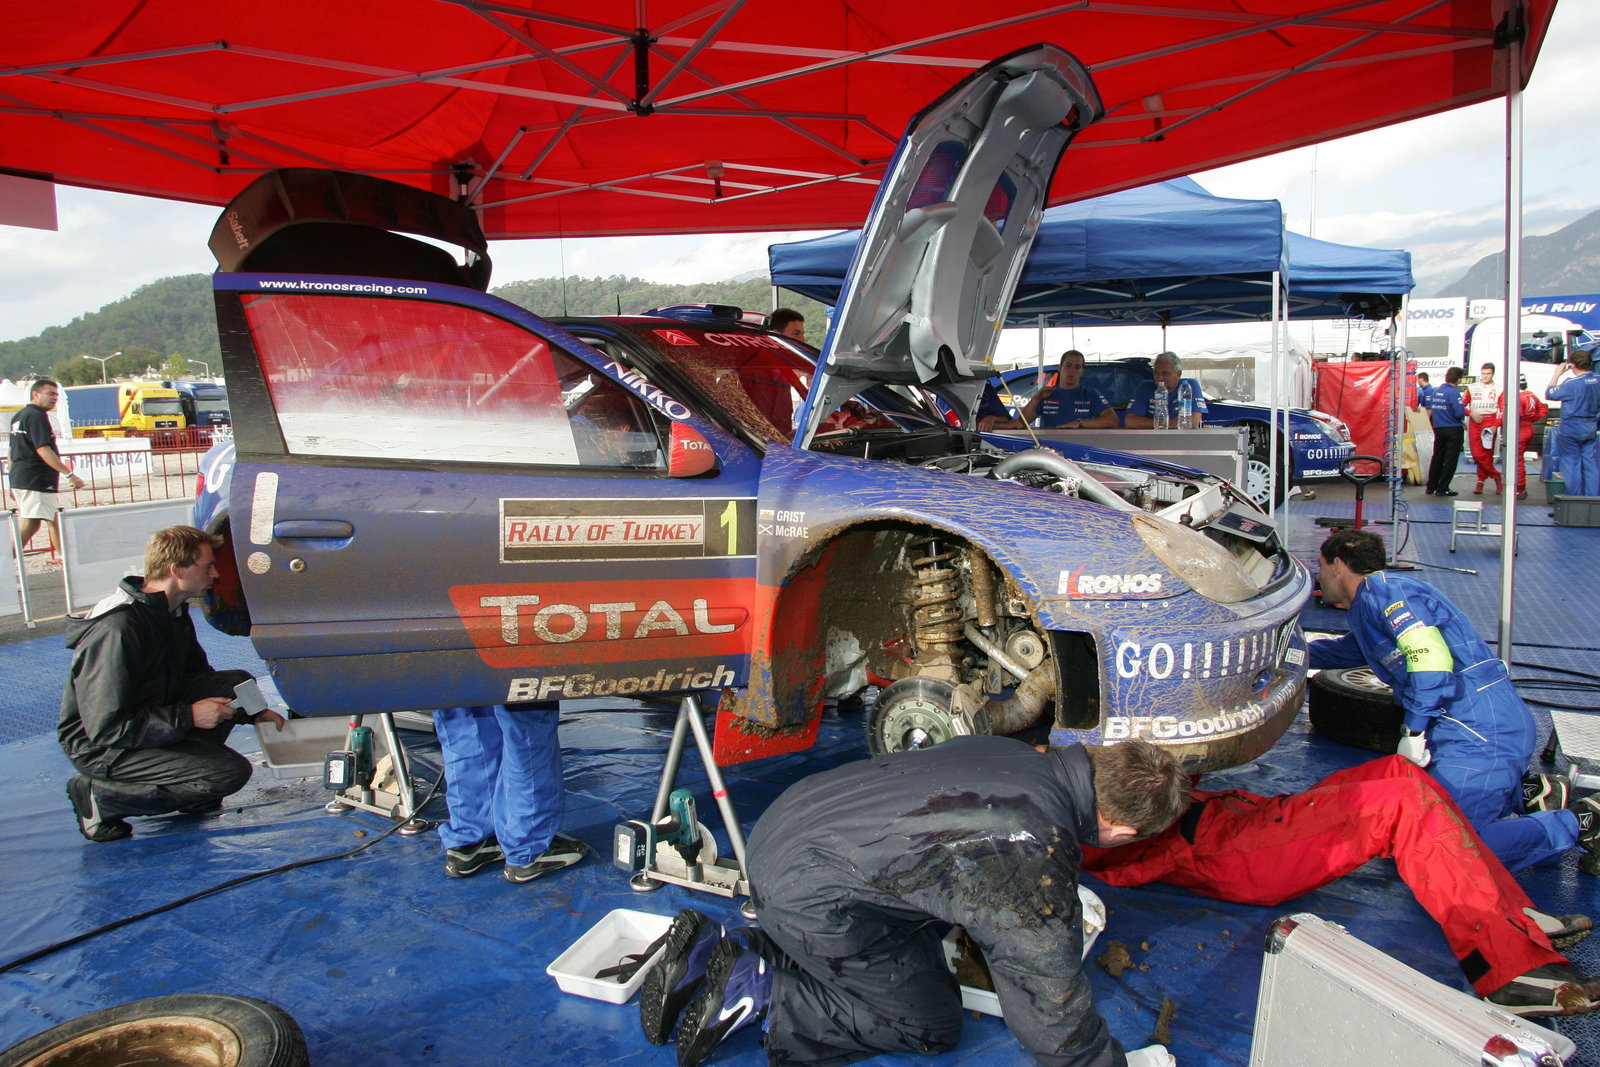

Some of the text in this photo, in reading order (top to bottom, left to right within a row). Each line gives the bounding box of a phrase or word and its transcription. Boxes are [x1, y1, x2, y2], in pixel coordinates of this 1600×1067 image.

[227, 210, 249, 249] Sabelt
[259, 280, 428, 295] www.kronosracing.com
[1405, 308, 1455, 319] RONOS
[1473, 305, 1487, 315] C2
[1550, 302, 1597, 314] Rally
[704, 332, 780, 349] CITRO
[603, 361, 692, 420] NIKKO
[720, 500, 738, 555] 1
[776, 511, 806, 523] GRIST
[508, 520, 703, 542] RALLY OF TURKEY
[775, 526, 809, 539] McRAE
[1056, 563, 1163, 598] KRONOS
[480, 594, 736, 645] TOTAL
[506, 664, 736, 702] BFGoodrich
[1104, 701, 1266, 740] BFGoodrich
